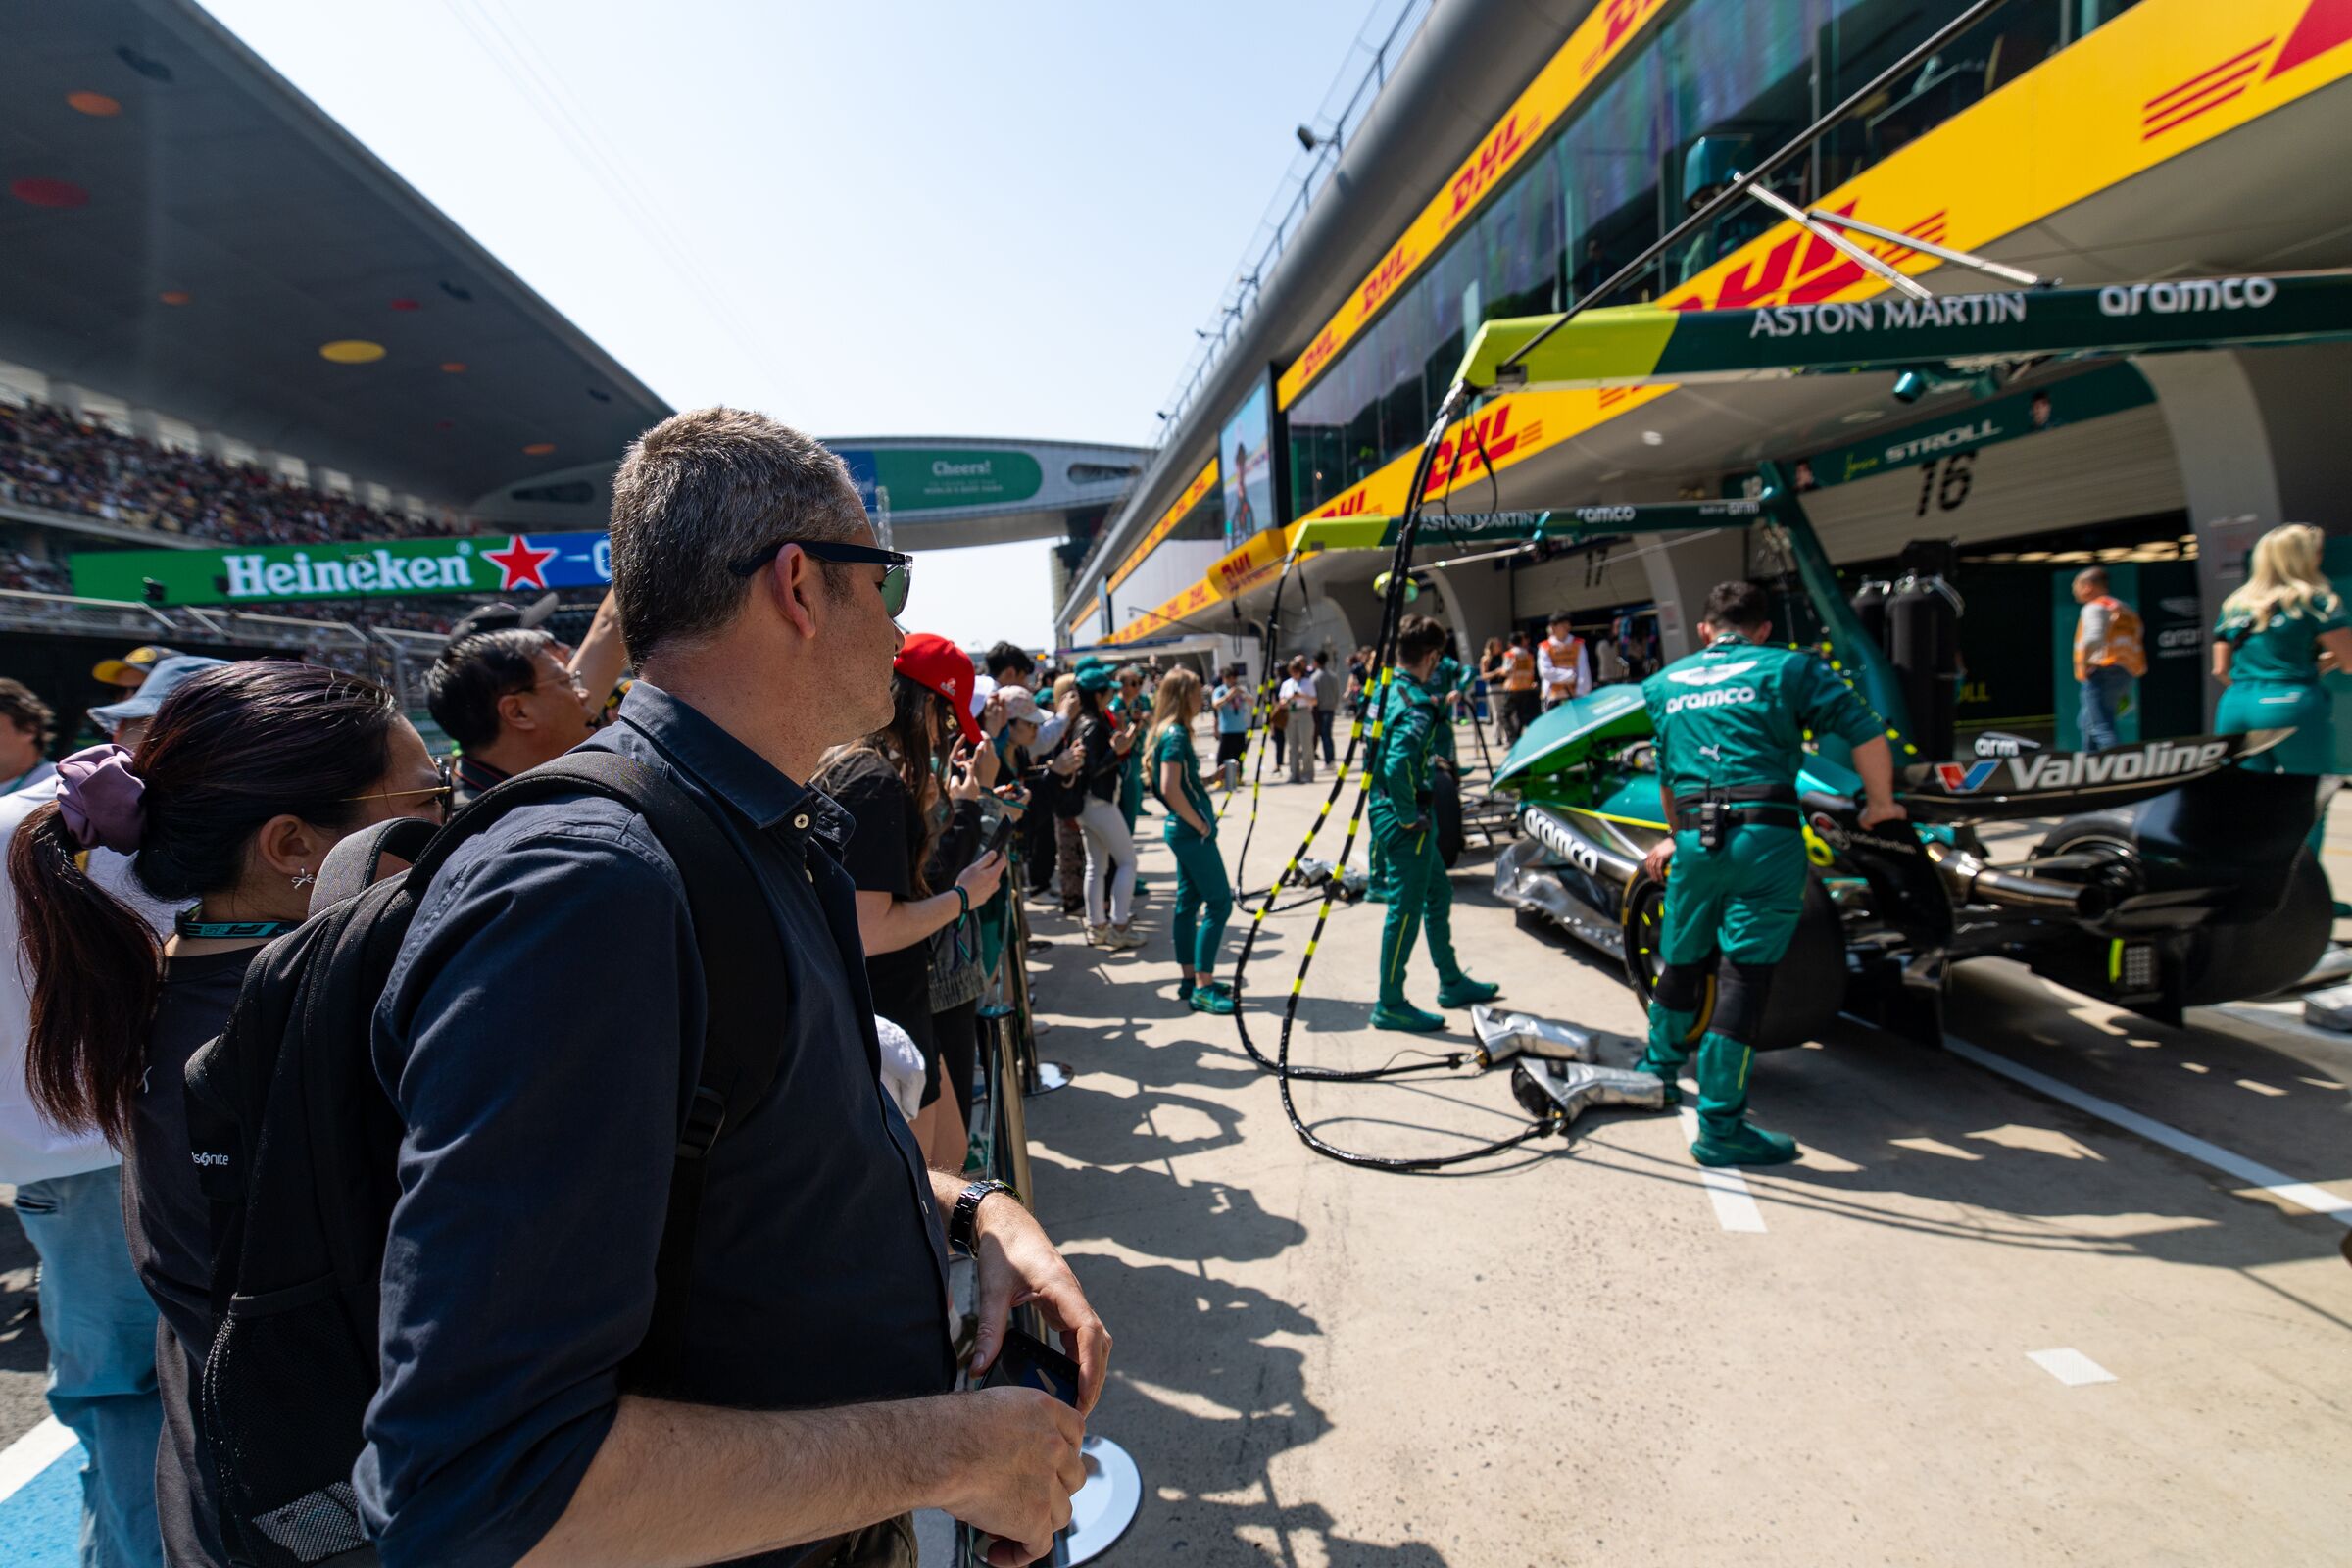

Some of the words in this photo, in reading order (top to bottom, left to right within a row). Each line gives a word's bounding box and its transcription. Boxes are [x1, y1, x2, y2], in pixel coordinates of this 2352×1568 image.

[1451, 114, 1521, 220] DHL
[1669, 197, 1876, 310] HL
[1749, 301, 1874, 338] ASTON
[1883, 292, 2027, 329] MARTIN
[2098, 277, 2276, 316] aramco
[1424, 404, 1519, 493] DHL
[1885, 419, 2003, 464] STROLL
[932, 460, 991, 476] Cheers!
[1916, 449, 1978, 517] 16
[1420, 514, 1473, 531] ASTON
[1475, 512, 1535, 529] MARTIN
[1576, 506, 1636, 523] ramco
[223, 550, 473, 597] Heineken
[1666, 686, 1756, 714] aramco
[1974, 737, 2020, 758] arm
[2008, 741, 2229, 791] Valvoline
[1524, 808, 1599, 876] aramco
